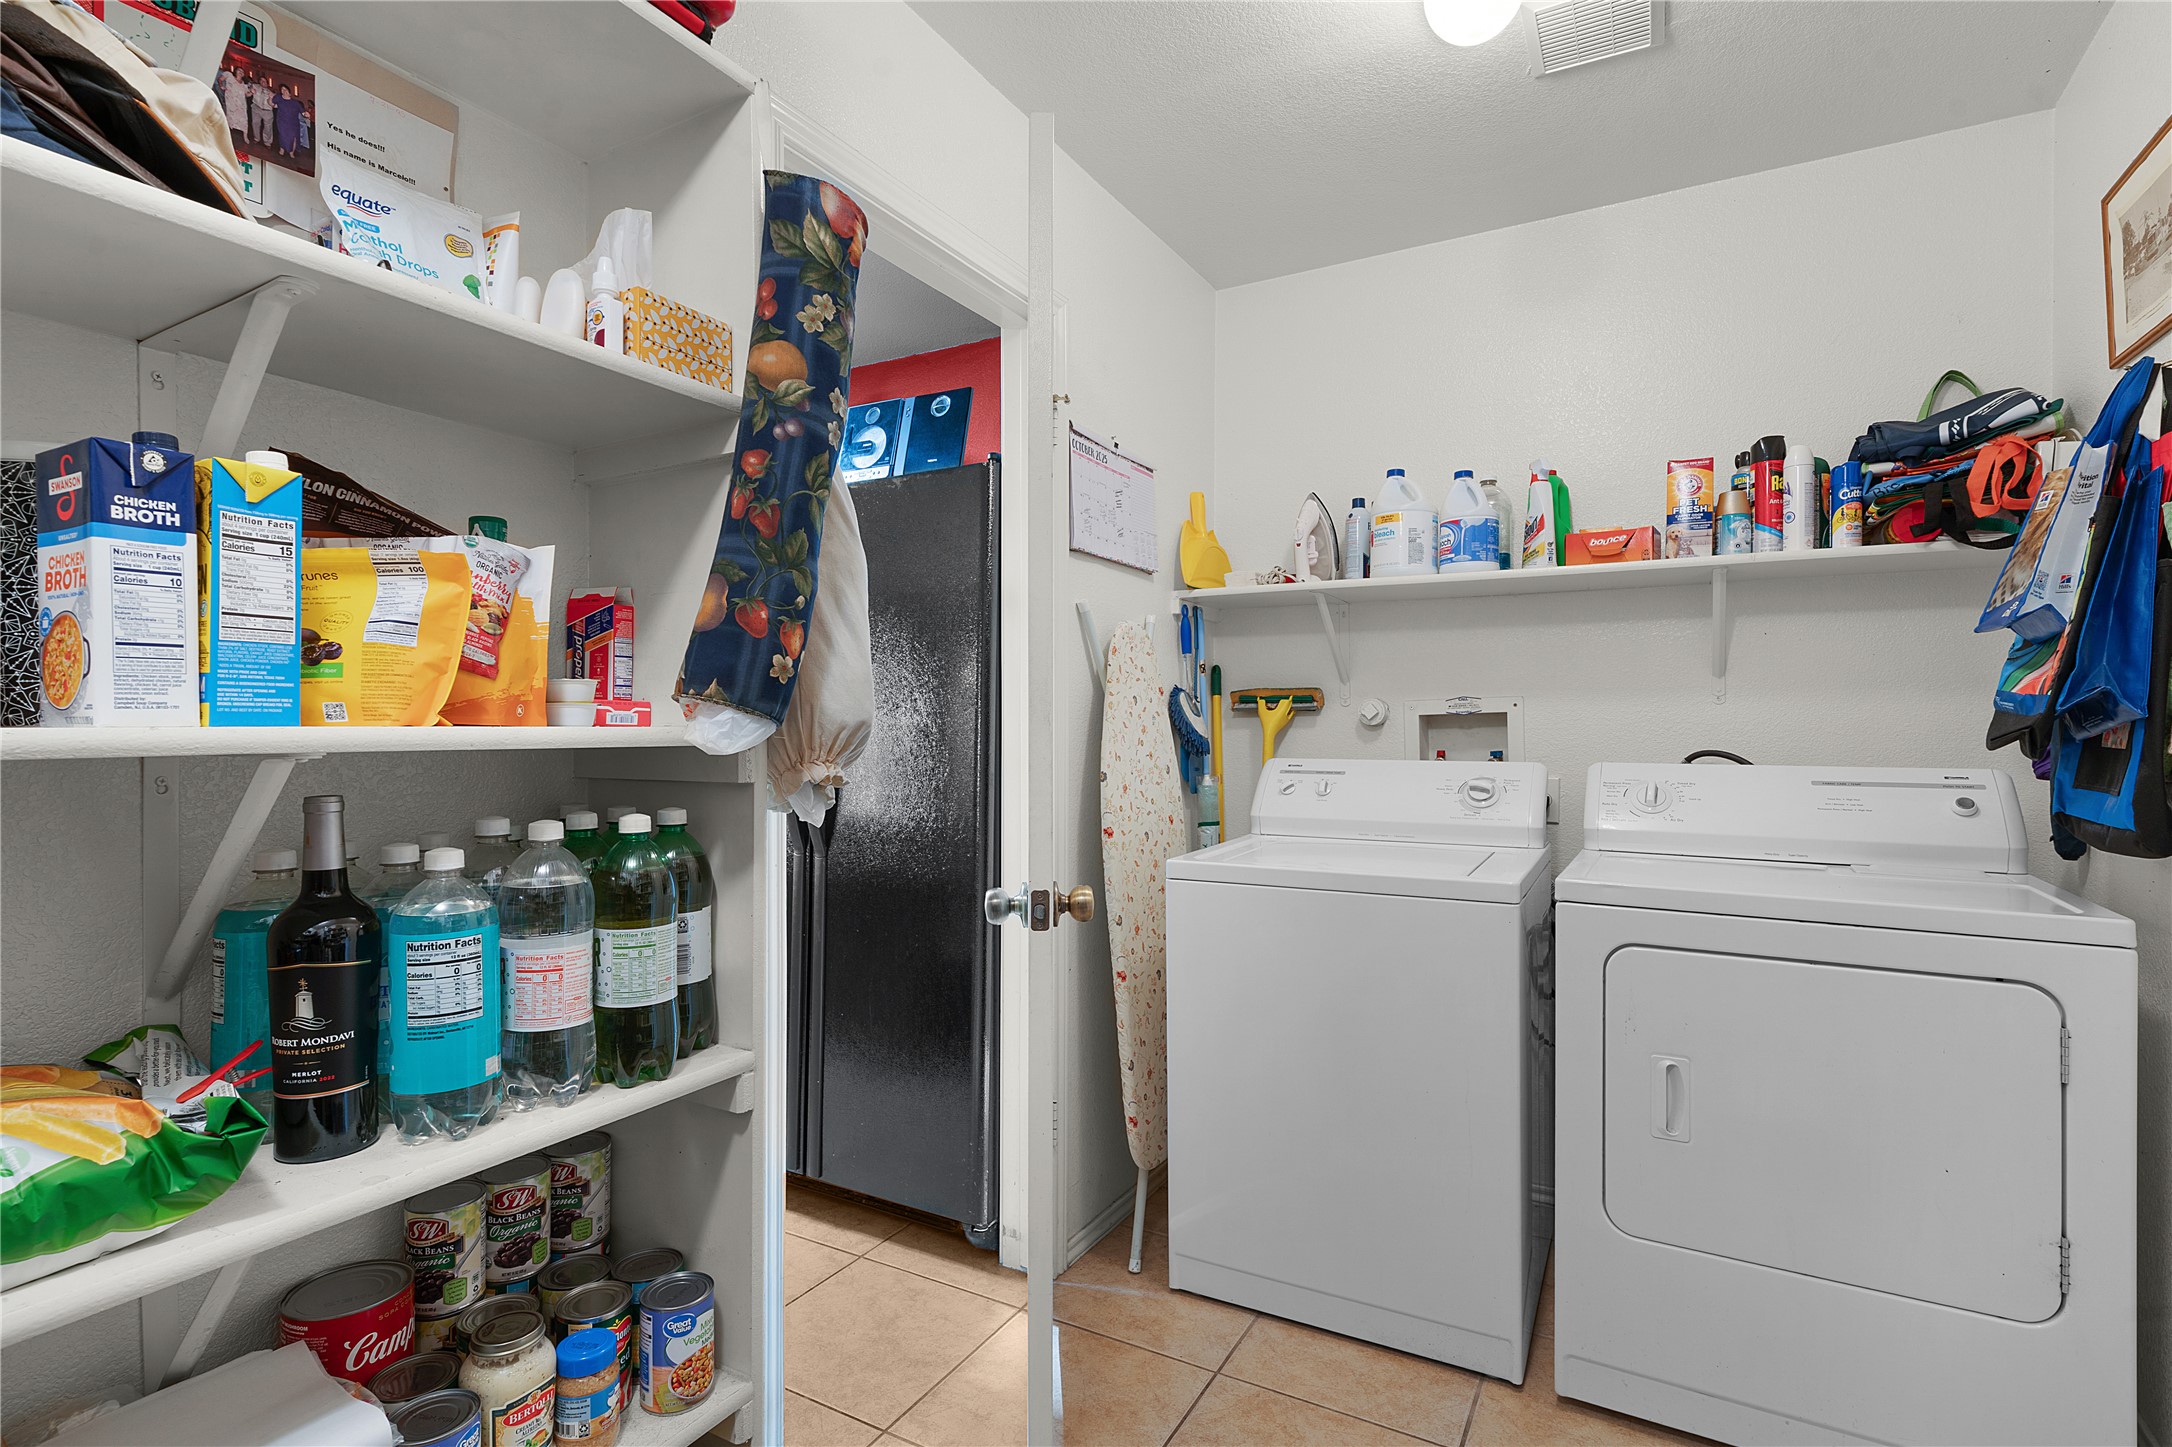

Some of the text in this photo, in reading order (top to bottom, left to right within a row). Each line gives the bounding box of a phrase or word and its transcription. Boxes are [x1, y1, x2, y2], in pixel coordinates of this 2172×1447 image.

[327, 122, 385, 153] Yes he does!!!
[327, 141, 416, 186] His name is Marcelo!!!
[331, 184, 392, 215] equate
[397, 253, 440, 280] Drops
[1072, 438, 1096, 459] OCTOBER
[51, 475, 81, 493] SWANSON
[1772, 475, 1784, 491] Ra
[1680, 498, 1700, 506] PET
[1839, 489, 1862, 500] Cutt
[113, 494, 177, 512] CHICKEN
[303, 477, 335, 497] LON
[335, 487, 411, 525] CINNAMON
[411, 521, 446, 537] POW
[1673, 505, 1708, 514] FRESH
[110, 504, 181, 527] BROTH
[222, 512, 263, 526] Nutrition
[268, 520, 294, 530] Facts
[222, 527, 240, 535] Serving
[222, 541, 293, 556] Calories 15
[1589, 534, 1627, 547] bounce
[48, 550, 85, 570] CHICKEN
[113, 548, 182, 562] Nutrition Facts
[301, 572, 339, 581] runes
[476, 560, 503, 579] ORGANIC
[45, 566, 87, 593] BROTH
[113, 574, 182, 587] Calories 10
[573, 635, 583, 680] prope
[407, 937, 482, 952] Nutrition Facts
[454, 967, 460, 975] 0
[476, 963, 482, 971] 0
[272, 1031, 355, 1047] ROBERT MONDAVI
[301, 1044, 346, 1055] SELECTION
[557, 1187, 582, 1195] BEANS
[488, 1207, 541, 1224] BLACK BEANS
[489, 1219, 538, 1241] Organic
[405, 1244, 455, 1255] LACK BEANS
[378, 1307, 399, 1321] SOPA
[667, 1318, 692, 1330] Great
[673, 1325, 692, 1334] Value
[344, 1317, 415, 1372] Camp
